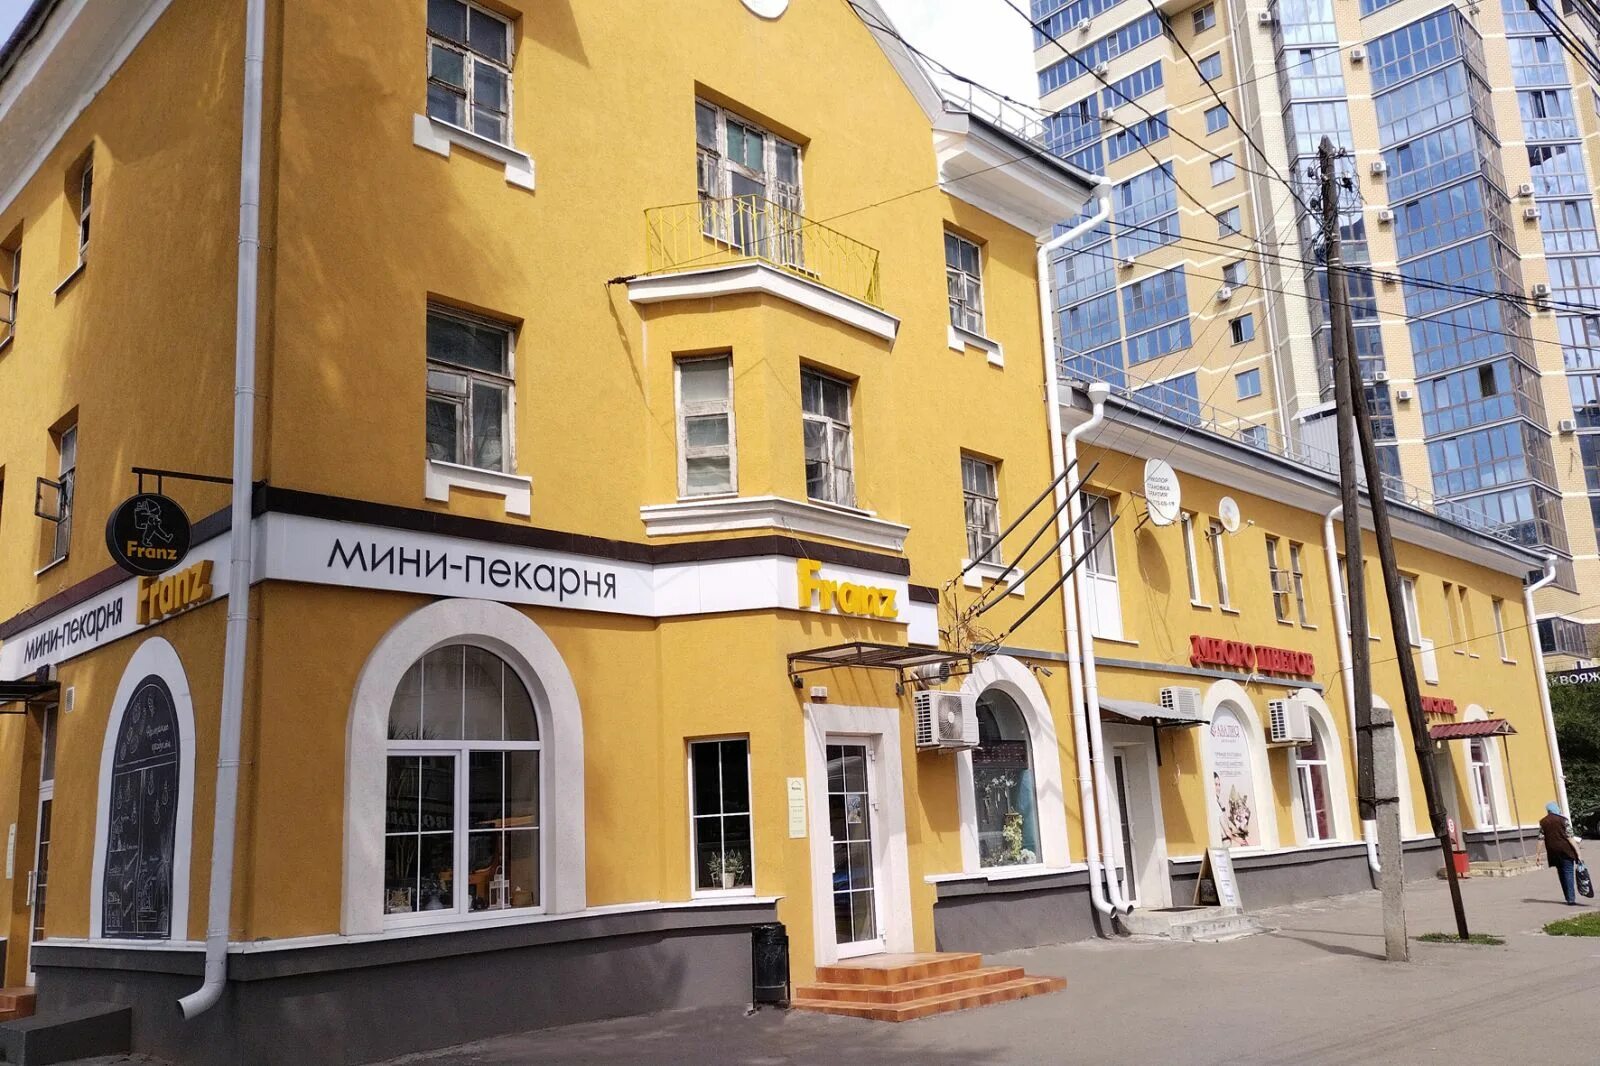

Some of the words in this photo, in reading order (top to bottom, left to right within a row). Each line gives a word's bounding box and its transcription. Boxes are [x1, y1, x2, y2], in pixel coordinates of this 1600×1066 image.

[127, 540, 177, 561] Franz
[136, 560, 214, 626] Franz
[797, 558, 898, 618] Franz
[1189, 634, 1255, 669] МНОГО
[1255, 645, 1315, 677] ЦВЕТОВ
